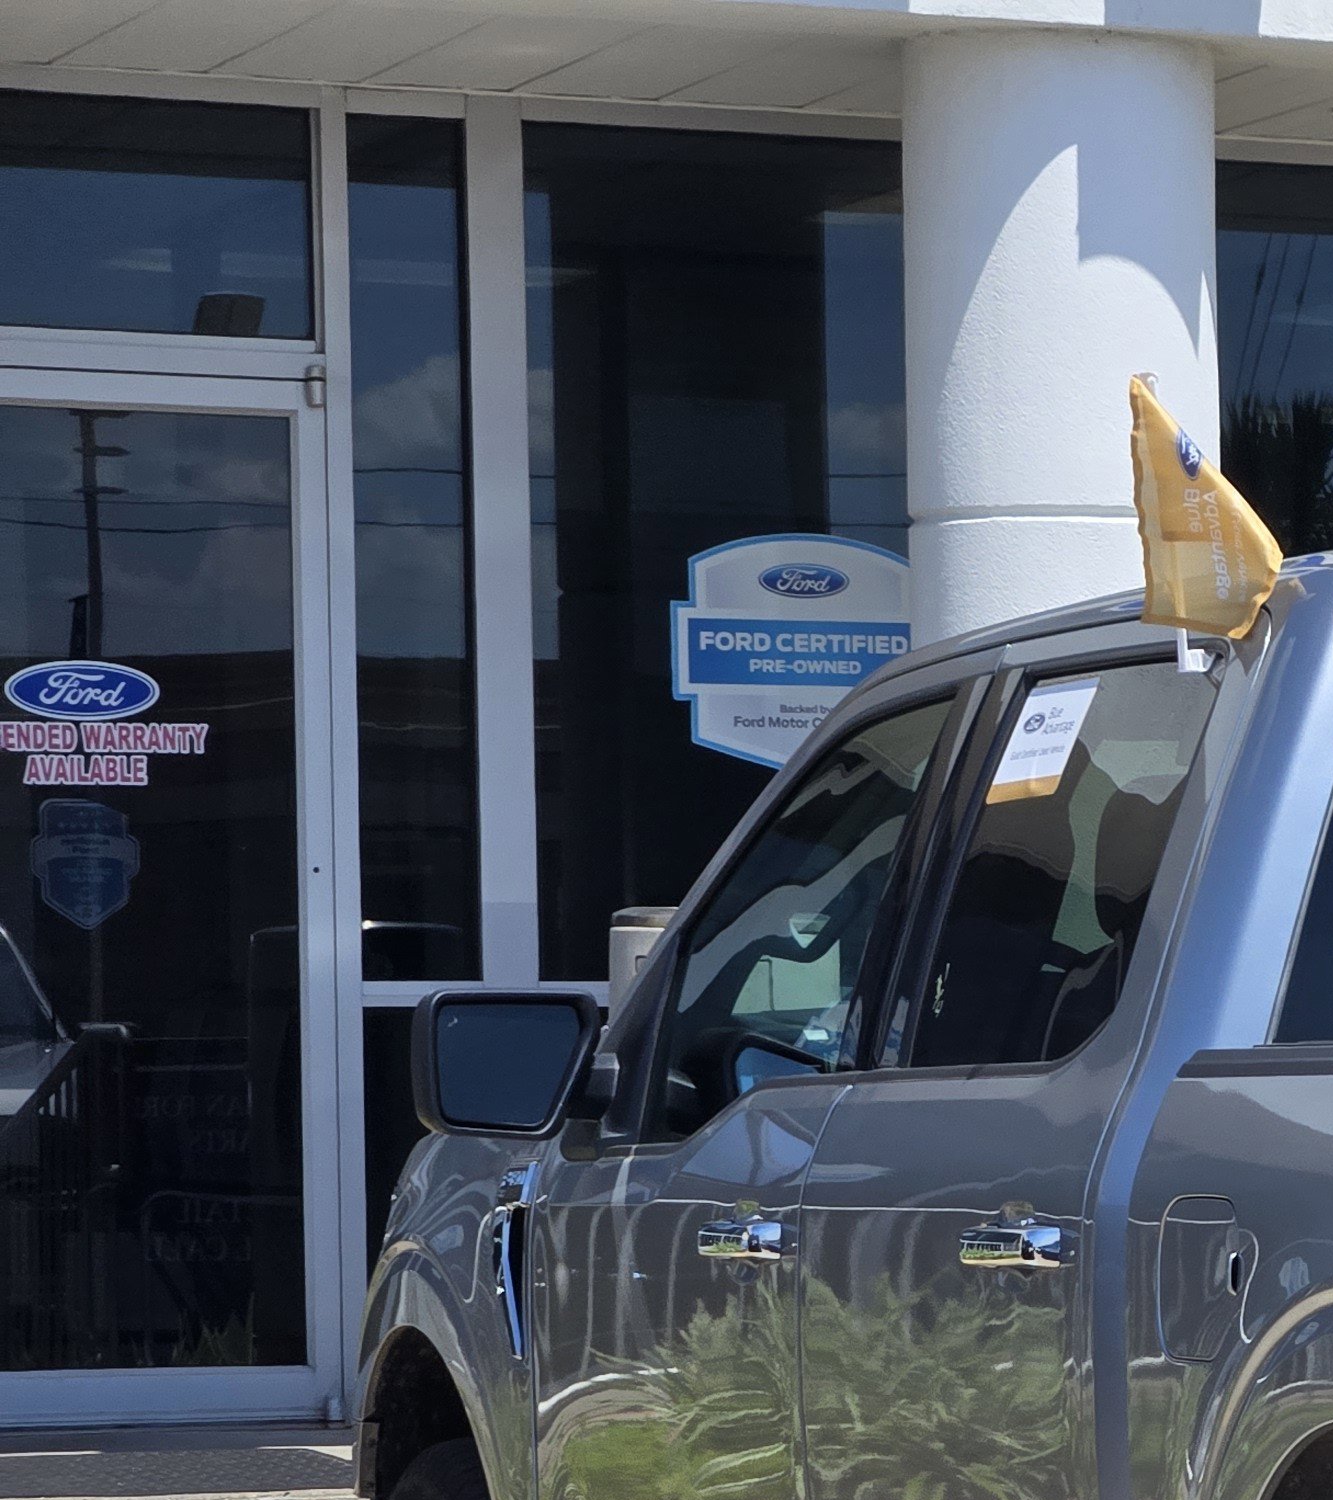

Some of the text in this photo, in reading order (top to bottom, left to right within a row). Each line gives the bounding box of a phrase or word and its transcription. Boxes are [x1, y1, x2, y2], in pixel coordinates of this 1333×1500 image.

[776, 568, 831, 592] Ford
[699, 630, 909, 655] FORD CERTIFIED
[749, 658, 863, 675] PRE-OWNED
[39, 671, 127, 706] Ford
[779, 704, 819, 714] Backed
[733, 716, 766, 728] Ford
[768, 717, 810, 729] Motor
[0, 723, 206, 753] ENDED WARRANTY
[26, 756, 146, 783] AVAILABLE
